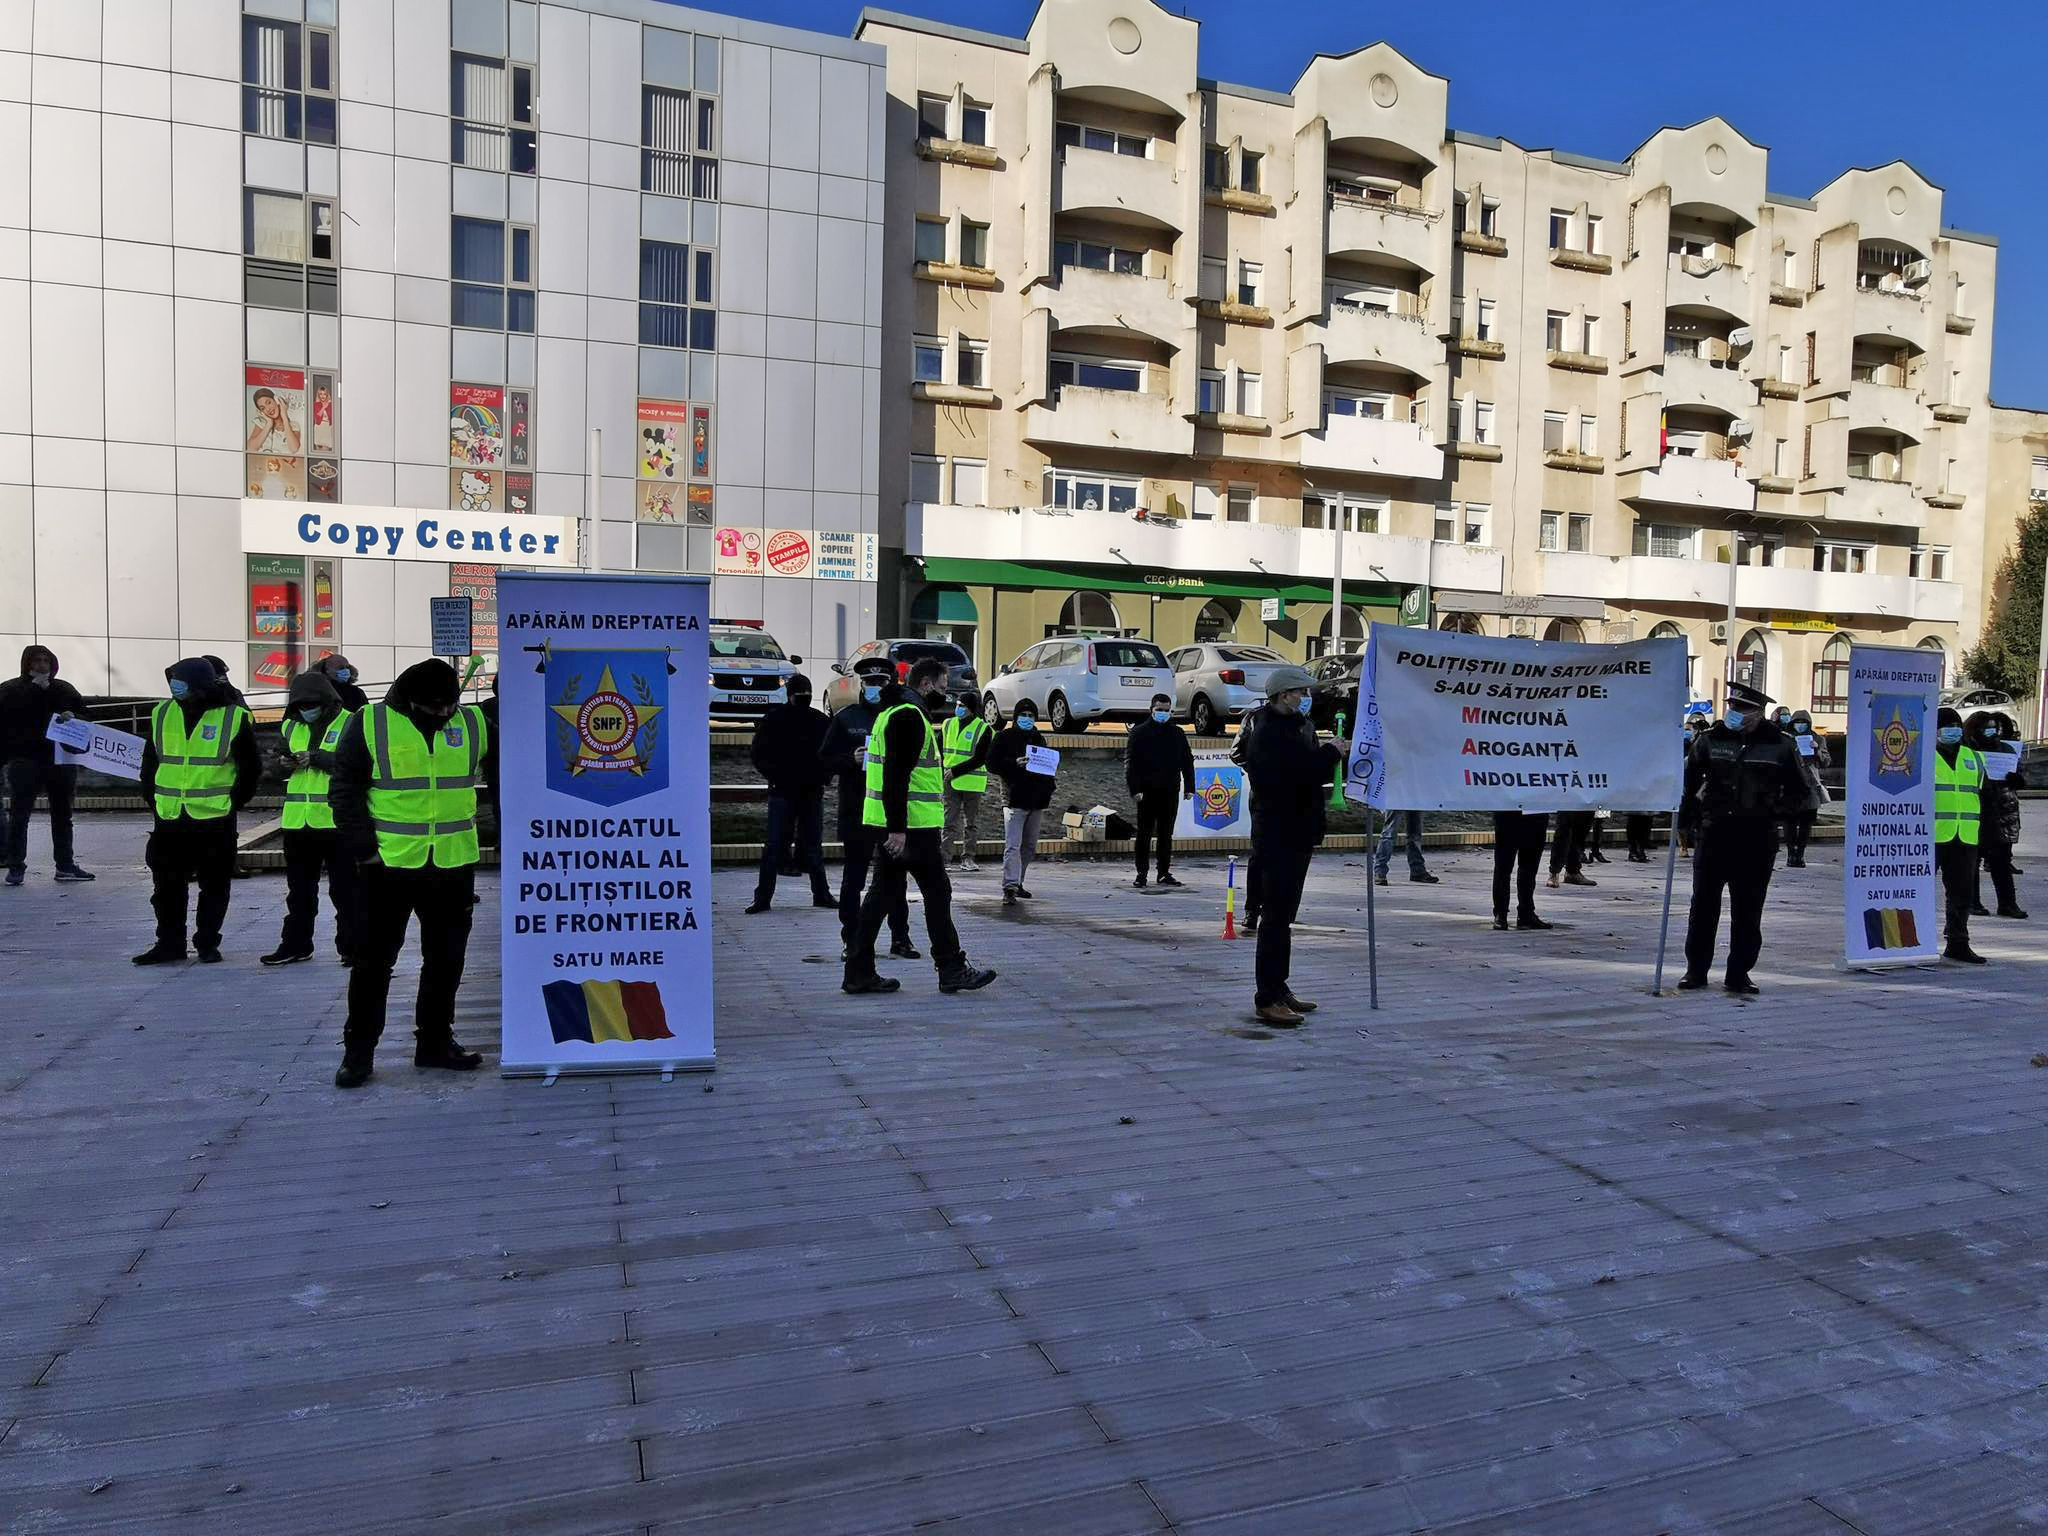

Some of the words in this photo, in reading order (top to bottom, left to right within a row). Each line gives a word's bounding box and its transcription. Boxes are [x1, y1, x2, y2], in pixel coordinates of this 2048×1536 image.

[297, 513, 404, 556] Copy
[416, 519, 560, 555] Center
[819, 532, 855, 543] SCANARE
[821, 544, 853, 554] COPIERE
[866, 535, 874, 579] XEROX
[453, 564, 498, 576] XEROX
[817, 556, 856, 567] LAMINARE
[818, 569, 856, 579] PRINTARE
[1143, 574, 1165, 585] CEC
[1178, 576, 1204, 587] Bank
[451, 585, 498, 600] COLOR
[506, 610, 585, 629] APĂRĂM
[592, 614, 700, 631] DREPTATEA
[1396, 650, 1506, 677] POLIȚIȘTII
[1511, 663, 1547, 678] DIN
[1550, 665, 1598, 678] SATU
[1599, 660, 1652, 676] MARE
[1854, 668, 1889, 680] APĂRĂM
[1891, 671, 1937, 683] DREPTATEA
[1433, 680, 1481, 696] S-AU
[1486, 682, 1573, 700] SĂTURAT
[1576, 685, 1608, 699] DE:
[593, 717, 622, 731] SNPF
[1462, 706, 1569, 727] MINCIUNĂ
[1461, 737, 1579, 762] AROGANȚĂ
[1464, 769, 1584, 793] INDOLENȚĂ
[1861, 803, 1925, 816] SINDICATUL
[530, 818, 681, 839] SINDICATUL
[1858, 823, 1911, 841] NAȚIONAL
[1914, 823, 1928, 836] AL
[1856, 843, 1929, 860] POLIȚIȘTILOR
[522, 850, 650, 876] NAȚIONAL
[658, 849, 689, 869] AL
[1854, 865, 1866, 878] DE
[1869, 860, 1931, 878] FRONTIERĂ
[519, 880, 692, 908] POLIȚIȘTILOR
[1867, 890, 1890, 900] SATU
[1893, 889, 1916, 899] MARE
[515, 914, 547, 934] DE
[556, 906, 698, 933] FRONTIERĂ
[553, 951, 603, 968] SATU
[610, 950, 664, 967] MARE
